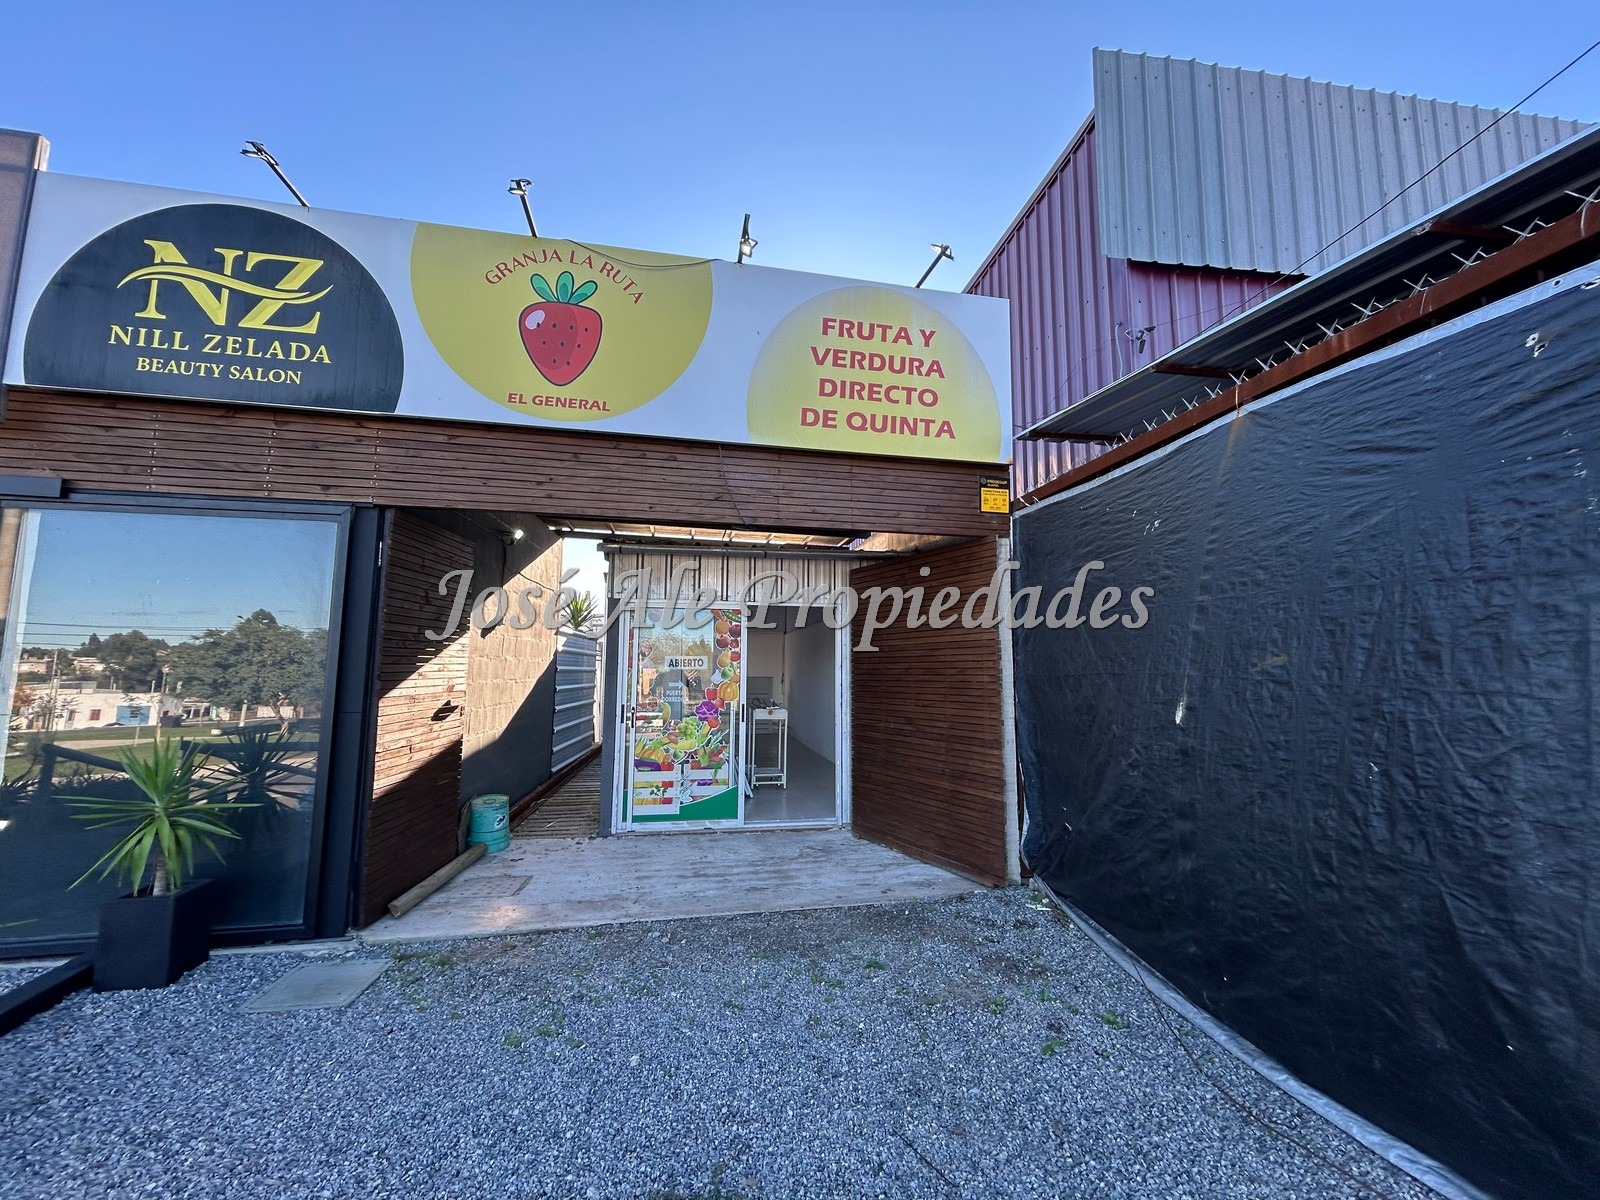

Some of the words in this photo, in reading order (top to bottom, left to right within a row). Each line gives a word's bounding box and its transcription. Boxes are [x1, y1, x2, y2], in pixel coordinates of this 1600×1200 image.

[135, 239, 325, 335] NZ
[484, 249, 563, 284] GRANJA
[569, 250, 594, 269] LA
[599, 261, 644, 304] RUTA
[108, 325, 190, 351] NILL
[202, 333, 332, 364] ZELADA
[821, 317, 913, 346] FRUTA
[918, 328, 937, 348] Y
[136, 357, 225, 379] BEAUTY
[229, 365, 302, 385] SALON
[810, 346, 945, 379] VERDURA
[507, 392, 528, 405] EL
[531, 394, 611, 412] GENERAL
[818, 378, 939, 408] DIRECTO
[800, 407, 838, 429] DE
[845, 411, 956, 440] QUINTA
[668, 658, 704, 668] ABIERTO
